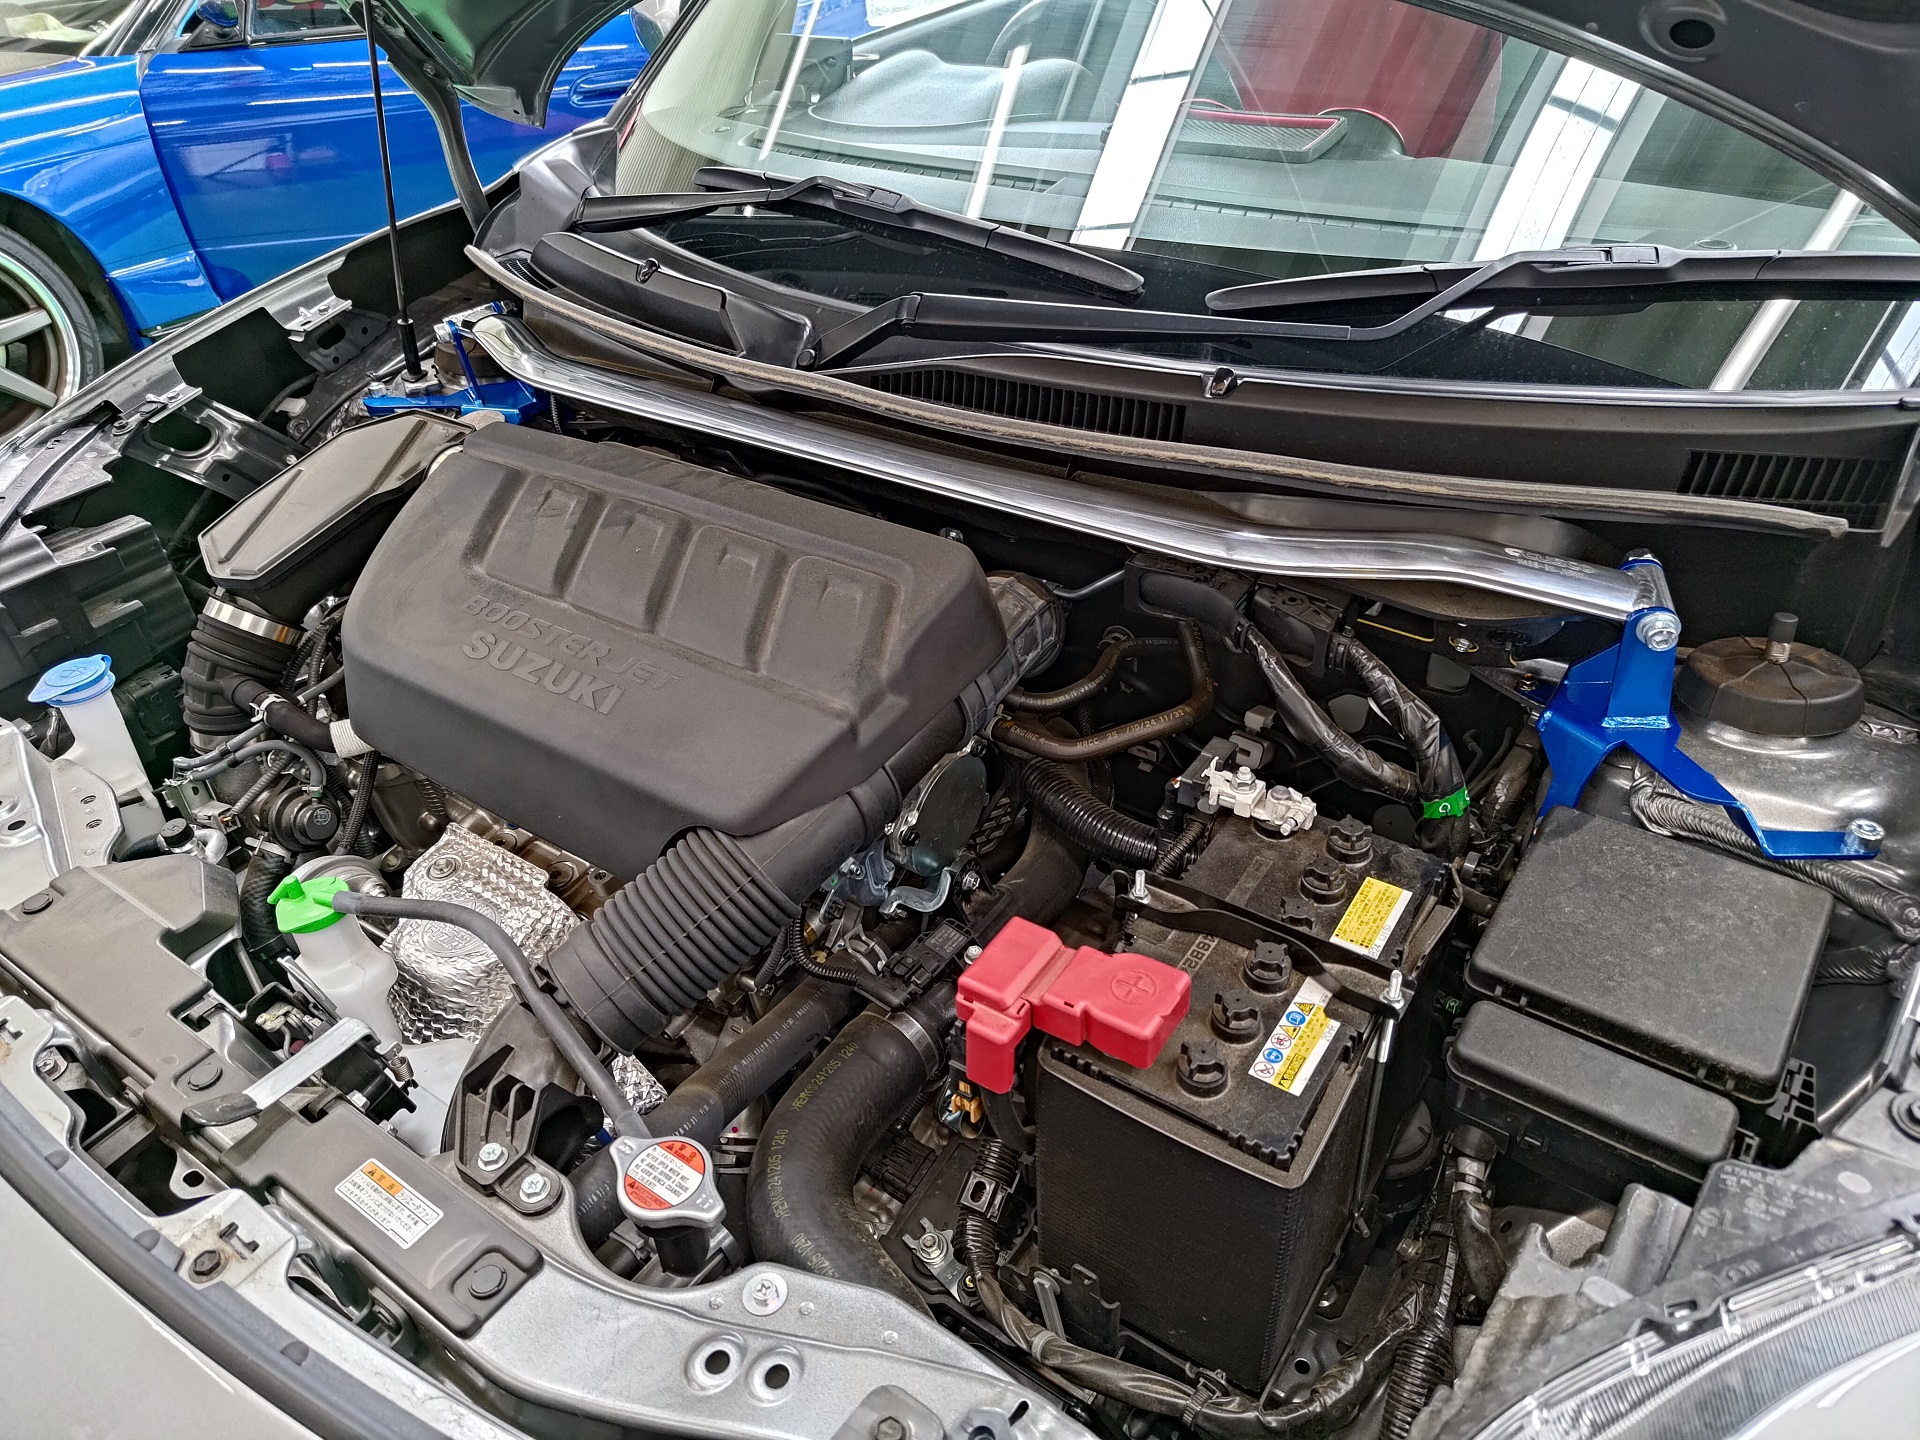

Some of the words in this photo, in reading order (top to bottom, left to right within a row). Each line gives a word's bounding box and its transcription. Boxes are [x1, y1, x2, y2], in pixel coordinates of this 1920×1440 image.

[460, 595, 611, 666] BOOSTER
[604, 657, 685, 690] JET
[462, 631, 626, 716] SUZUKI
[1010, 724, 1040, 742] ENGINE
[1106, 730, 1119, 742] 25
[1126, 719, 1157, 735] /10/24
[1159, 709, 1185, 725] 11/32
[839, 1042, 859, 1060] 1240
[771, 1129, 789, 1151] 1240
[645, 1152, 658, 1163] NEVER
[658, 1160, 668, 1170] OPEN
[668, 1167, 681, 1177] WHEN
[791, 1232, 815, 1257] 1240
